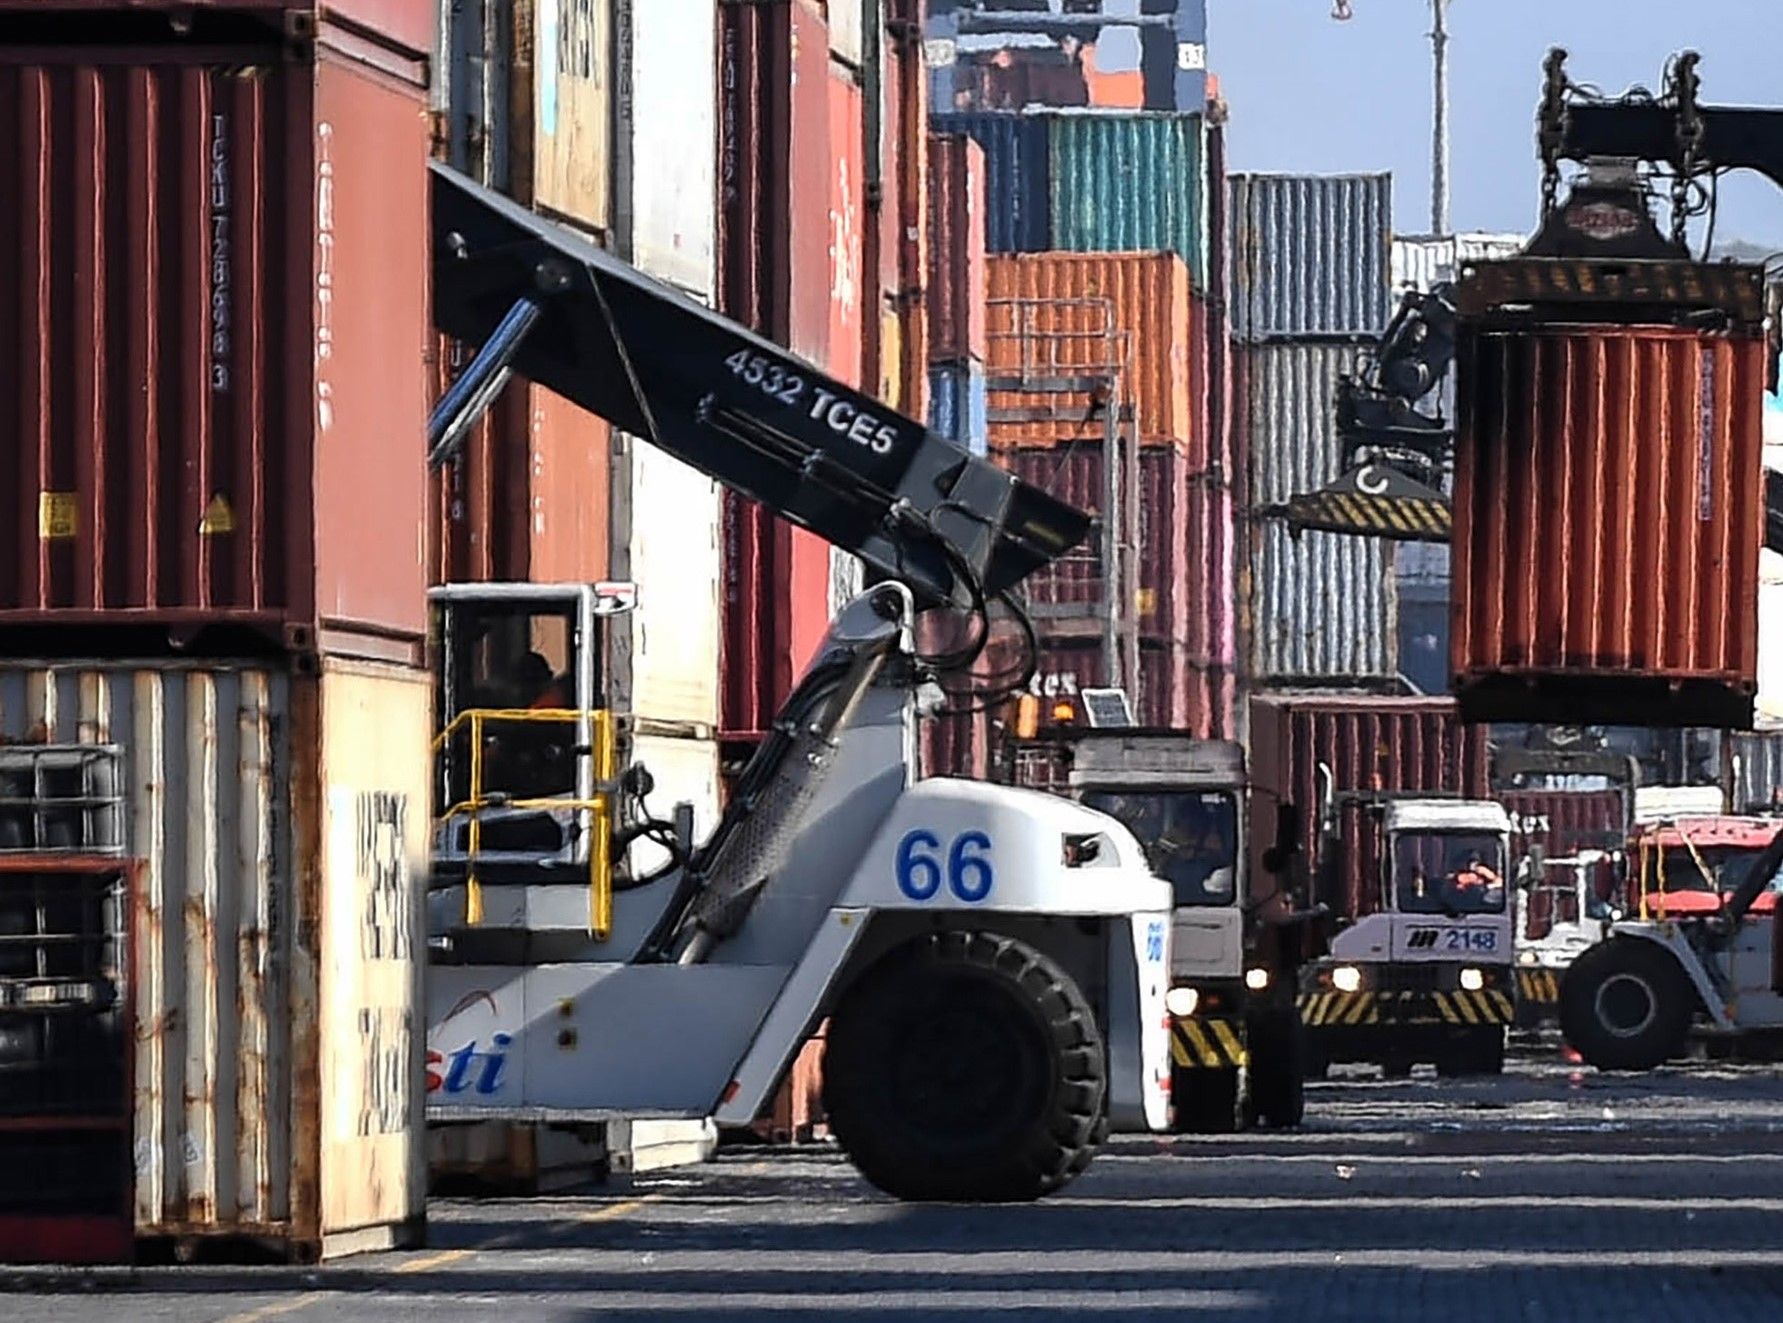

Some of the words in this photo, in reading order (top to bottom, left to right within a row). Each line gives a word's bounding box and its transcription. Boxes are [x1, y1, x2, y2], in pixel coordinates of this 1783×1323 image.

[213, 364, 228, 389] 3
[724, 350, 804, 406] 4532
[809, 386, 898, 454] TCE5
[895, 828, 994, 903] 66
[1446, 929, 1497, 950] 2148
